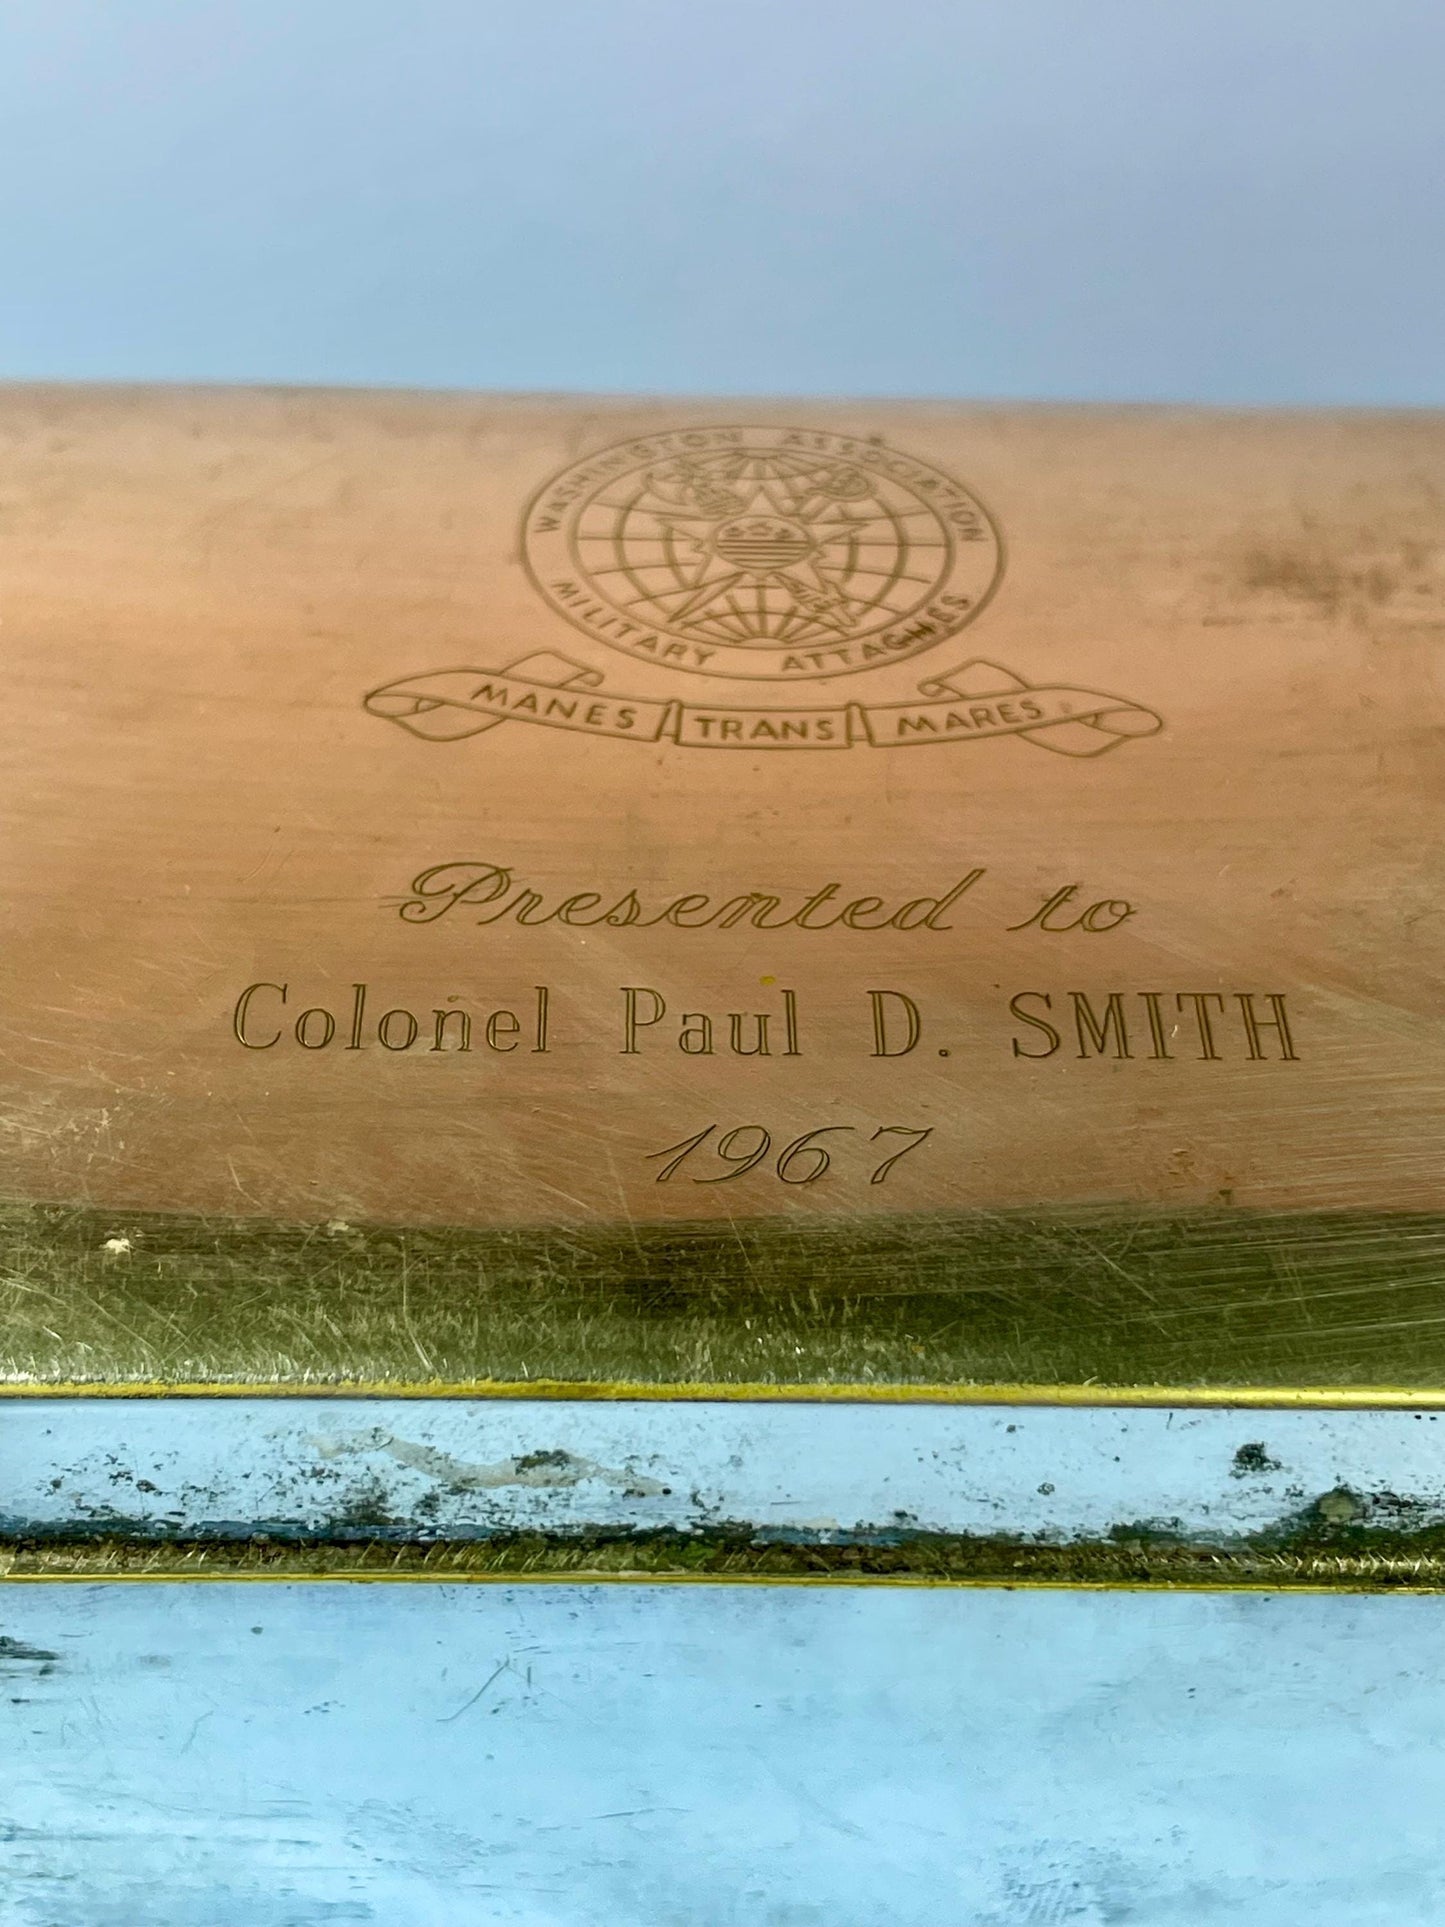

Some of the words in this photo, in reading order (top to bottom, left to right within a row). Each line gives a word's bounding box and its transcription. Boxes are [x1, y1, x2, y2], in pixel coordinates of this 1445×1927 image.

[534, 432, 743, 533] WASHINGTON
[781, 433, 988, 541] ASSOCIATION
[552, 582, 717, 665] MILITARY
[471, 684, 637, 729] MANES
[694, 715, 835, 741] TRANS
[898, 700, 1043, 735] MARES
[399, 861, 987, 930] Presented
[1006, 885, 1137, 932] to
[233, 983, 552, 1054] Colonel
[619, 987, 803, 1056] Paul
[867, 990, 950, 1058] D.
[1009, 991, 1300, 1061] SMITH
[645, 1124, 934, 1185] 1967
